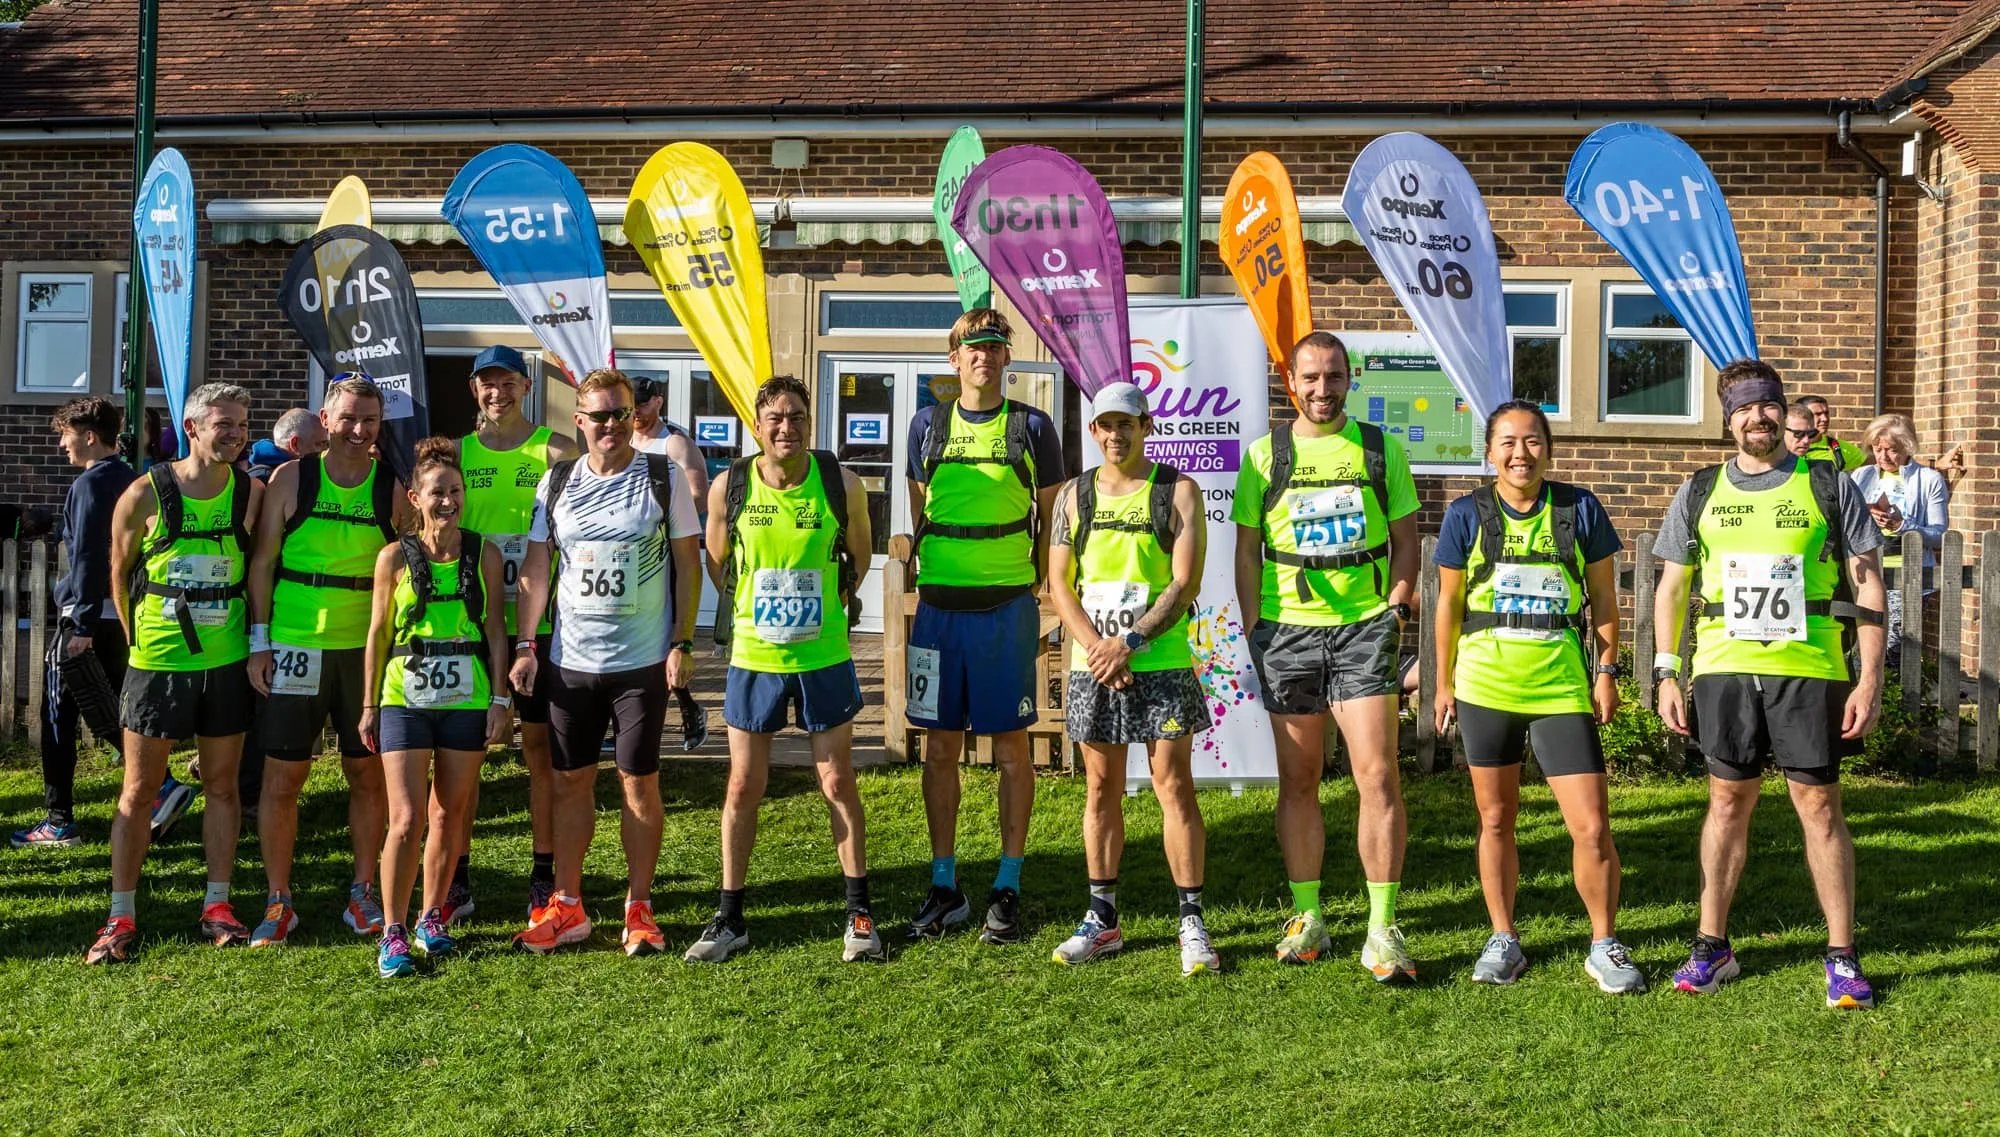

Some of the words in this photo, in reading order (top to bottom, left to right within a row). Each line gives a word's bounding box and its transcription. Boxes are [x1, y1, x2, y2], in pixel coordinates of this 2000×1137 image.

[1389, 358, 1408, 366] Village
[1179, 421, 1241, 435] GREEN
[1143, 443, 1218, 457] ENNINGS
[515, 461, 540, 478] Run
[1192, 456, 1225, 471] JOG
[466, 467, 498, 478] PACER
[1294, 466, 1317, 476] CER
[1334, 466, 1364, 480] Run
[472, 477, 493, 489] 1:35
[743, 504, 779, 514] PACER
[793, 505, 823, 519] Run
[1095, 510, 1115, 520] CER
[1711, 504, 1755, 515] PACER
[1771, 503, 1809, 517] Run
[749, 516, 773, 526] 55:00
[1719, 517, 1743, 527] 1:40
[1780, 520, 1807, 528] HALF
[1295, 511, 1363, 548] 2515
[580, 568, 626, 597] 563
[1734, 586, 1791, 621] 576
[756, 597, 819, 627] 2392
[413, 660, 461, 691] 565
